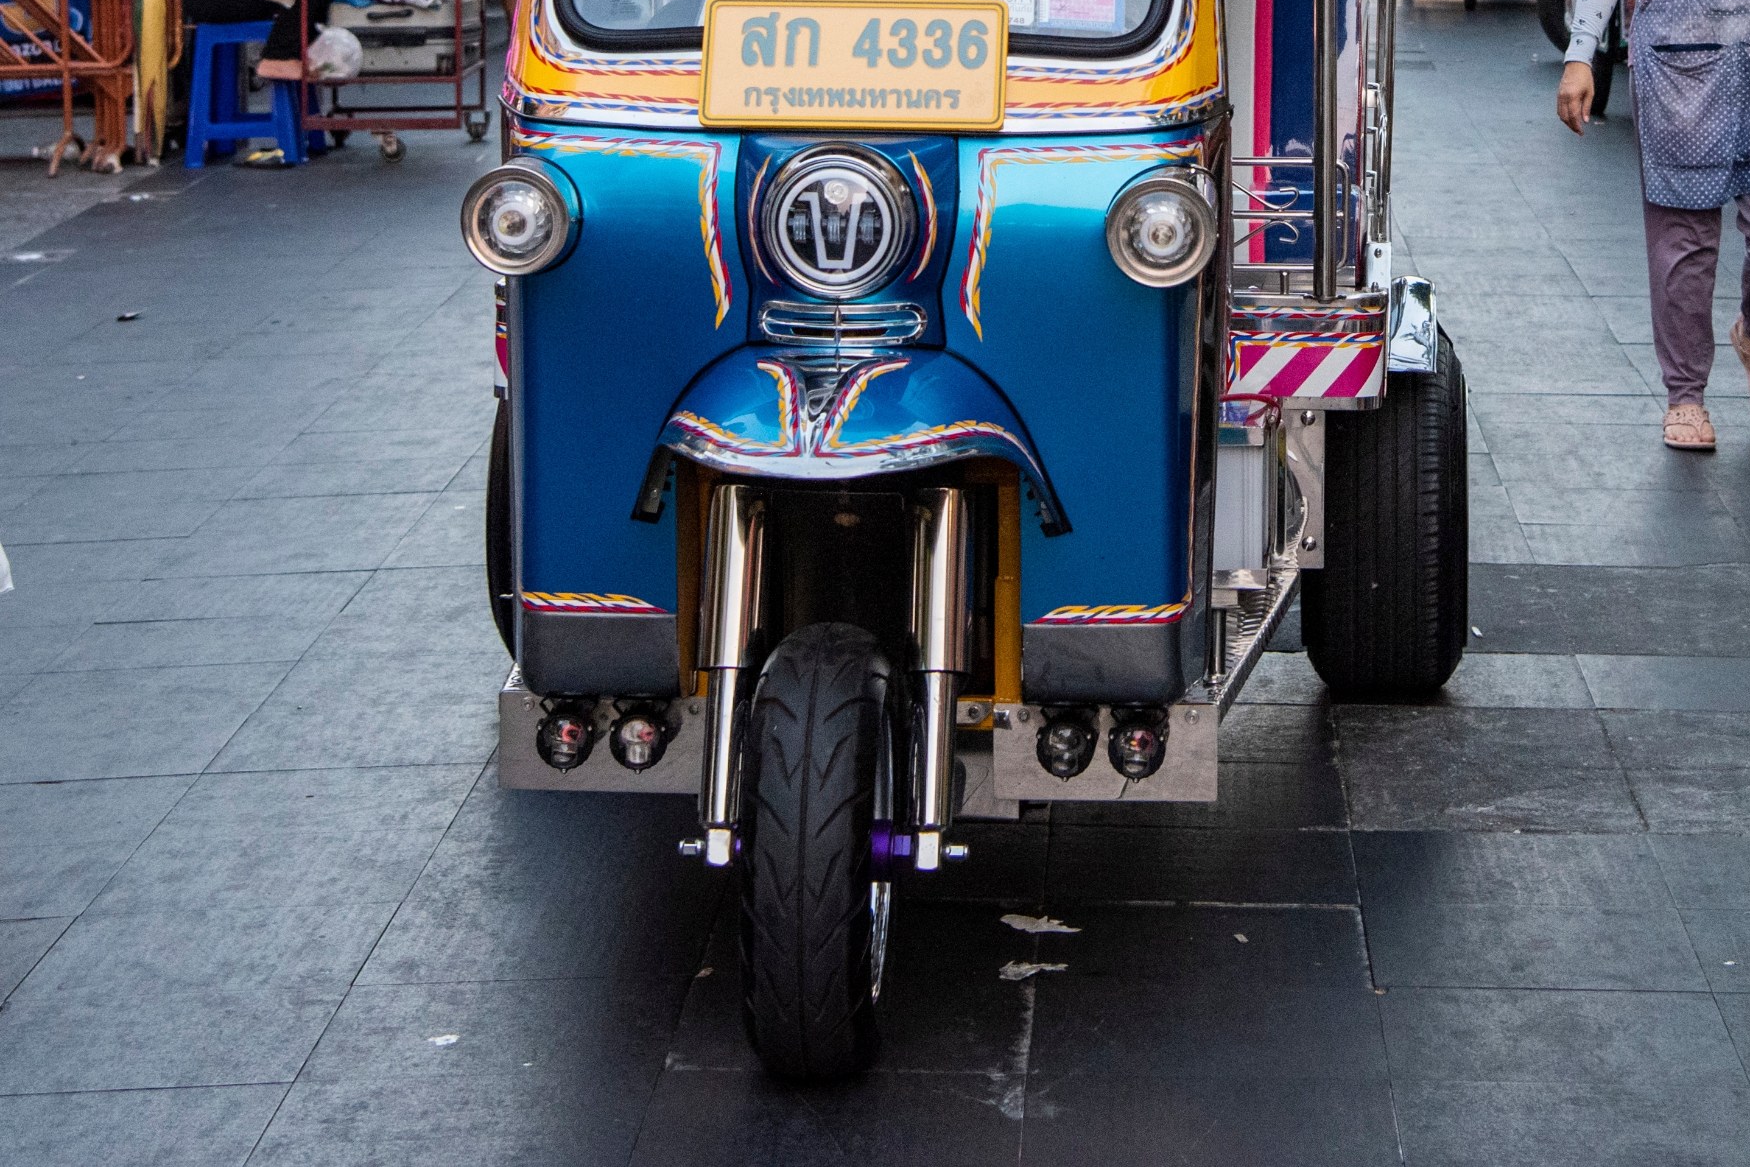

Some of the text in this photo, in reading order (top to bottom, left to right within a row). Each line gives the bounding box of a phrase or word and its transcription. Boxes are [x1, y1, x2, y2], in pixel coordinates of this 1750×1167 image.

[740, 10, 989, 70] สก 4336
[743, 83, 961, 115] กรุงเทพมหานคร
